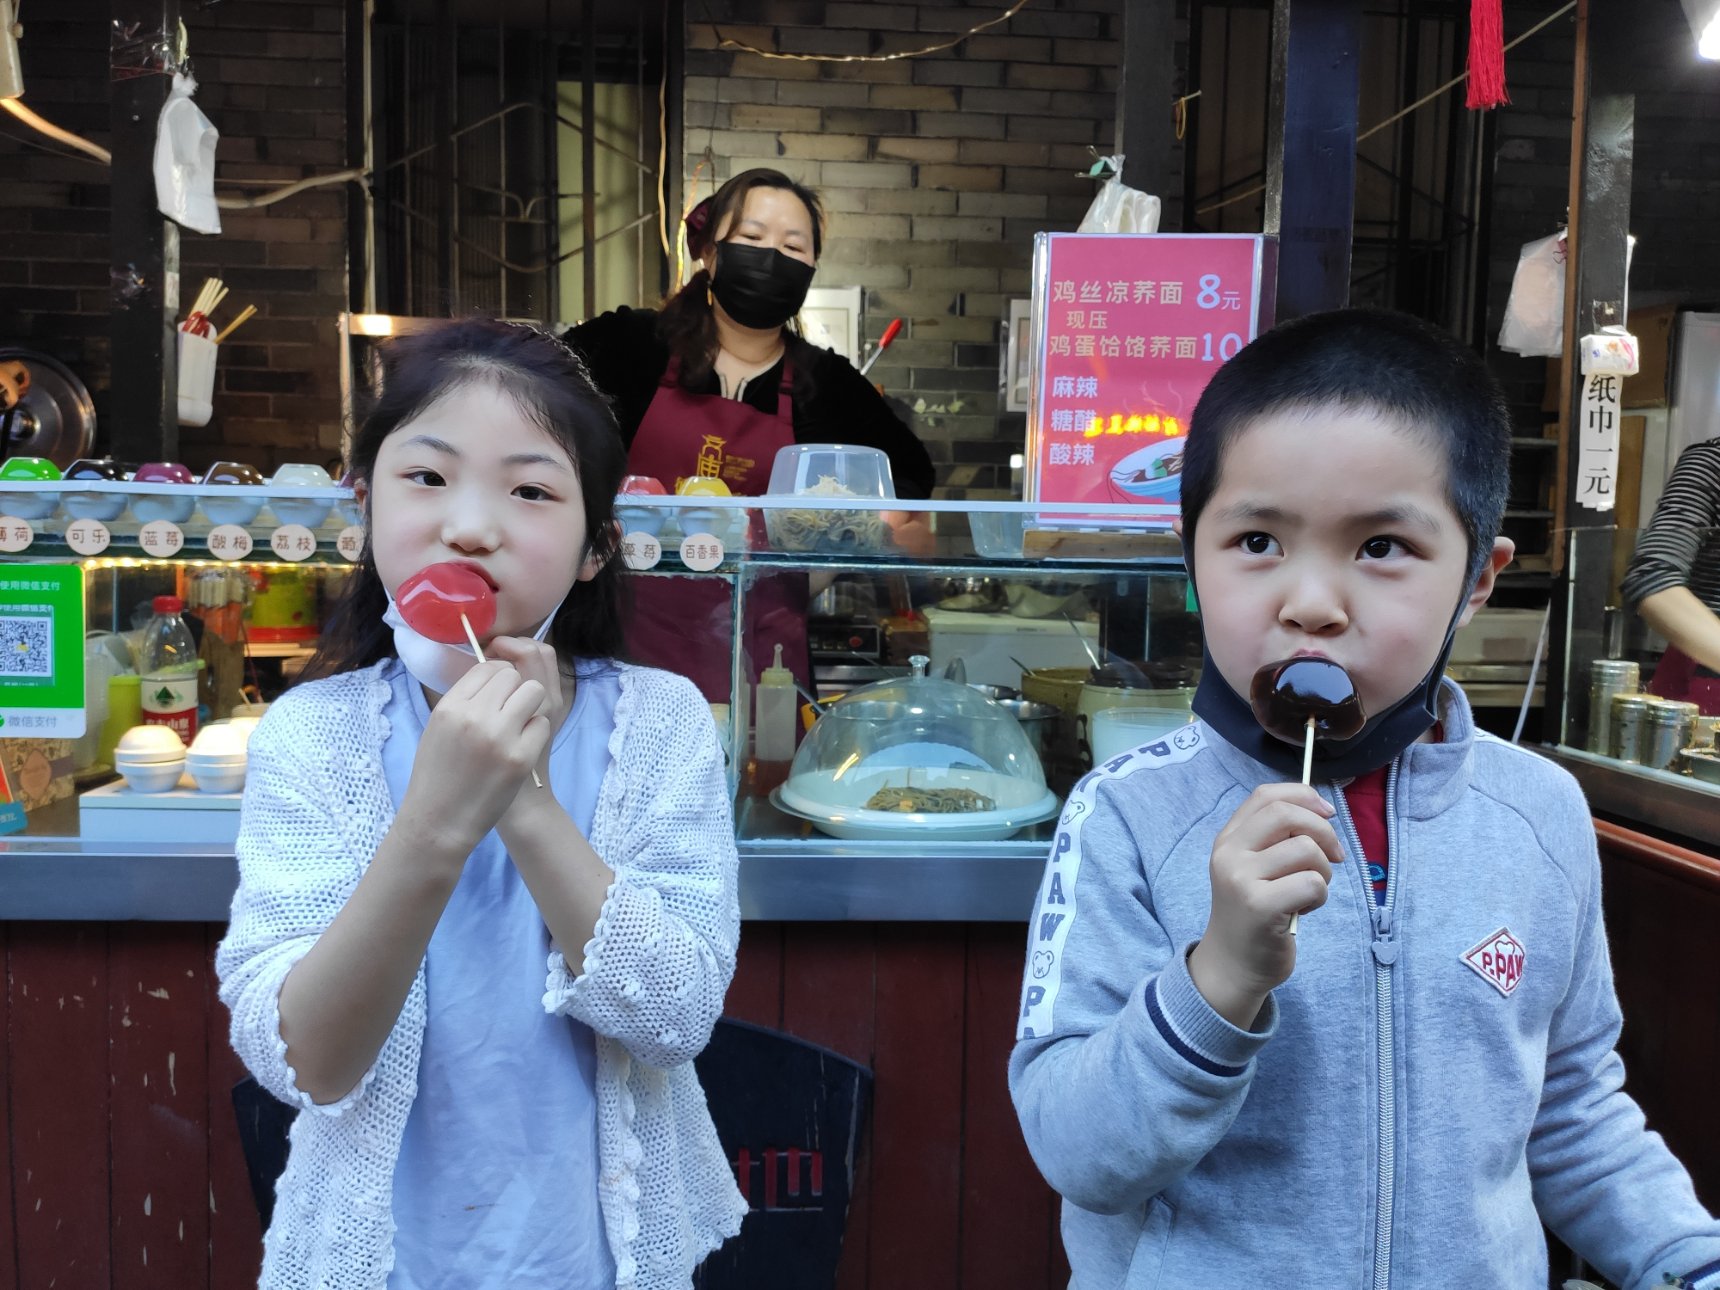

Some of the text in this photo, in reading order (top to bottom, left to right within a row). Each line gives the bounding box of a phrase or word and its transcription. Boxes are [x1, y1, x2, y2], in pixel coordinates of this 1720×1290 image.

[1053, 280, 1184, 305] 鸡丝凉荞面
[1066, 311, 1108, 329] 现压
[1049, 332, 1242, 362] 鸡蛋饸饹荞面 10
[1052, 376, 1098, 398] 麻辣
[1051, 409, 1097, 432] 糖醋
[1584, 374, 1617, 495] 纸巾一元
[1049, 443, 1095, 466] 酸辣
[71, 528, 106, 544] 可乐
[144, 531, 179, 547] 蓝莓
[212, 534, 248, 551] 酸梅
[276, 534, 312, 552] 荔枝
[622, 542, 656, 560] 草莓
[685, 544, 719, 560] 百香果
[8, 715, 57, 728] 微信支付
[1040, 832, 1071, 941] PAW
